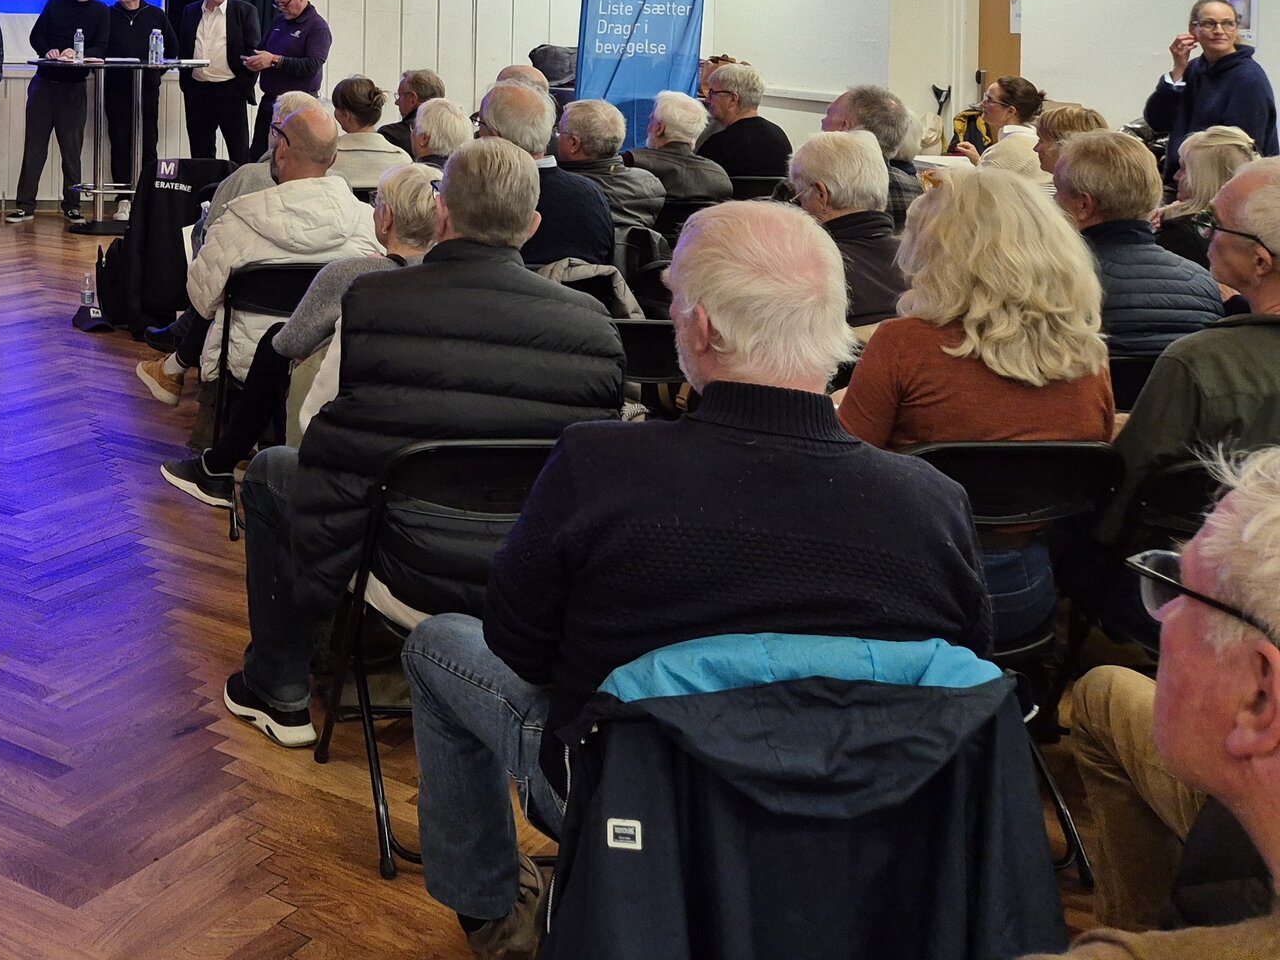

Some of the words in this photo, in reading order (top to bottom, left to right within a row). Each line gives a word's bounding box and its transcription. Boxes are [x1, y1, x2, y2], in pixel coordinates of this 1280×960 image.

[598, 0, 633, 16] Liste
[643, 1, 693, 16] sætter
[597, 19, 640, 39] Dragr
[644, 19, 649, 34] i
[160, 161, 175, 176] M
[154, 181, 192, 192] ERATERNE
